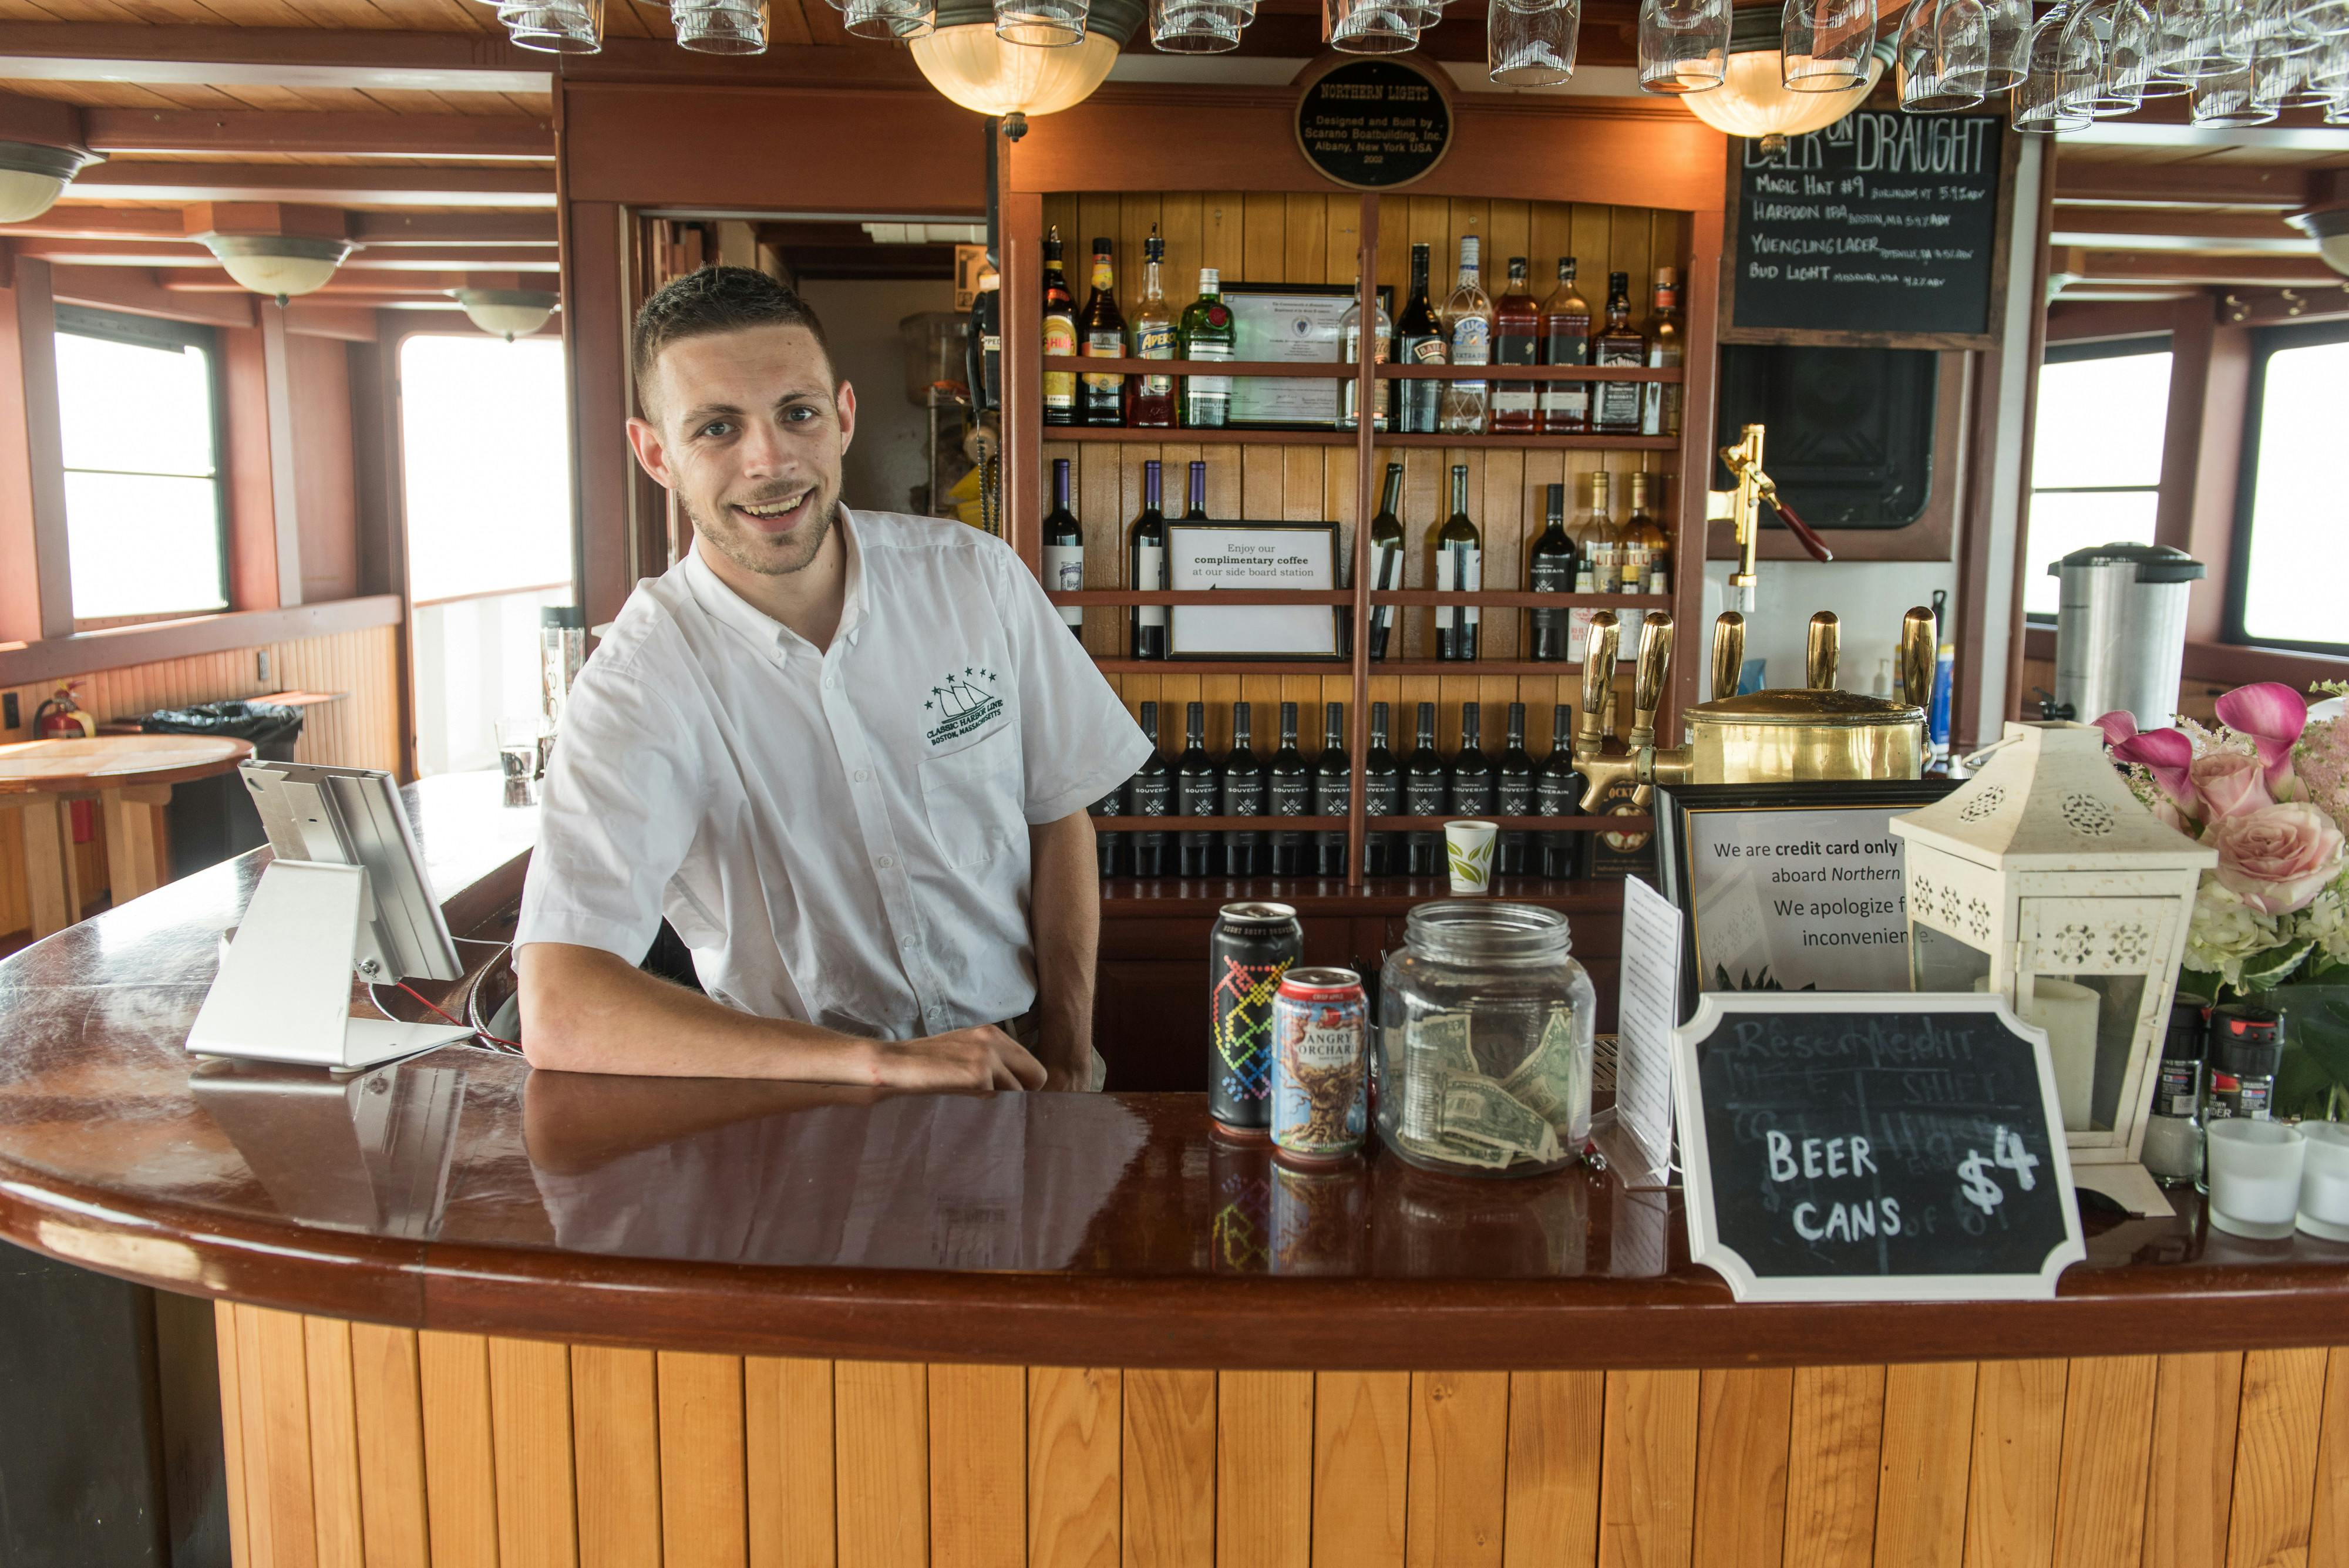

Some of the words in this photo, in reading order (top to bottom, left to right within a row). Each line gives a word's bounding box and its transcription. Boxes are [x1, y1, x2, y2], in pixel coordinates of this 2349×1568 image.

[1321, 84, 1382, 99] NORTHERN
[1388, 85, 1429, 101] LIGHTS
[1315, 116, 1364, 127] Designed
[1369, 117, 1388, 126] and
[1392, 117, 1416, 126] Built
[1420, 119, 1433, 129] by
[1305, 127, 1348, 139] Scarano
[1352, 129, 1419, 142] Boatbuilding,
[1424, 130, 1442, 141] Inc.
[1856, 113, 1995, 173] DRAUGHT
[1315, 142, 1352, 153] Albany,
[1357, 143, 1379, 151] New
[1384, 143, 1405, 152] York
[1409, 143, 1432, 153] USA
[1755, 173, 1799, 195] MAGIC
[1840, 176, 1865, 198] #9
[1753, 200, 1820, 221] HARPOON
[1825, 204, 1847, 220] IPA
[1751, 233, 1835, 255] YUENGLING
[1835, 236, 1879, 255] LAGER
[1749, 261, 1779, 279] BUD
[1227, 544, 1256, 554] Enjoy
[1194, 556, 1274, 566] complimentary
[1226, 568, 1246, 576] side
[926, 722, 959, 739] CLASSIC
[960, 706, 987, 726] HARBOR
[987, 699, 1004, 713] LINE
[931, 731, 959, 746] BOSTON,
[960, 709, 1001, 735] MASSACHUSETTS
[1713, 843, 1741, 857] We
[1746, 846, 1771, 857] are
[1775, 840, 1822, 856] credit
[1826, 840, 1860, 855] card
[1864, 839, 1898, 857] only
[1772, 867, 1827, 883] aboard
[1832, 866, 1901, 882] Northern
[1773, 900, 1804, 916] We
[1810, 897, 1894, 919] apologize
[1307, 1033, 1352, 1044] ANGRY
[1766, 1130, 1877, 1182] BEER
[1957, 1124, 2040, 1216] $4
[1792, 1197, 1902, 1243] CANS
